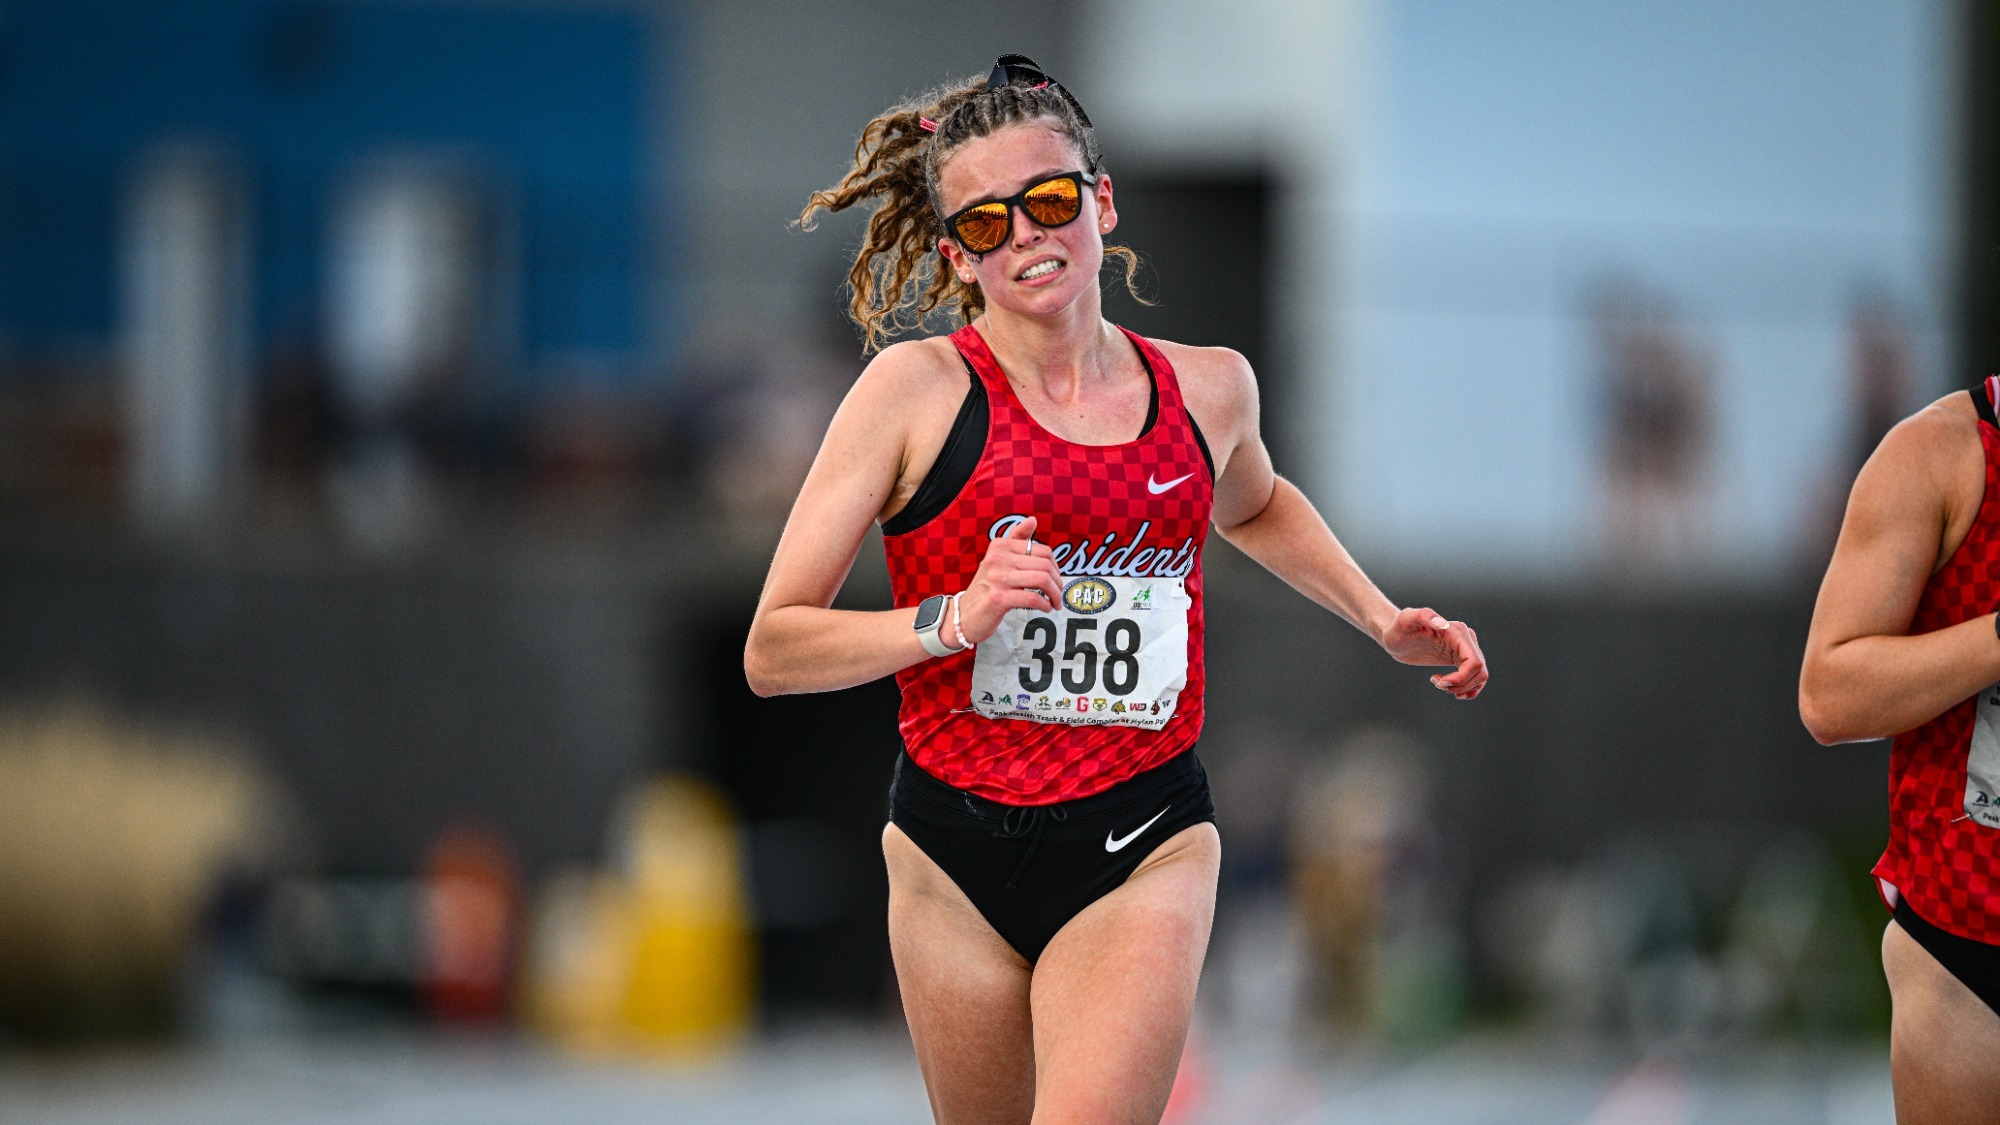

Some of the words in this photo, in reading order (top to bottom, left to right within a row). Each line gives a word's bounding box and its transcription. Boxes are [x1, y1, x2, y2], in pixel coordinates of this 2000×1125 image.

[1073, 588, 1105, 605] PAC
[1018, 617, 1141, 696] 358
[1037, 714, 1057, 722] Track
[1983, 812, 2000, 822] Peak
